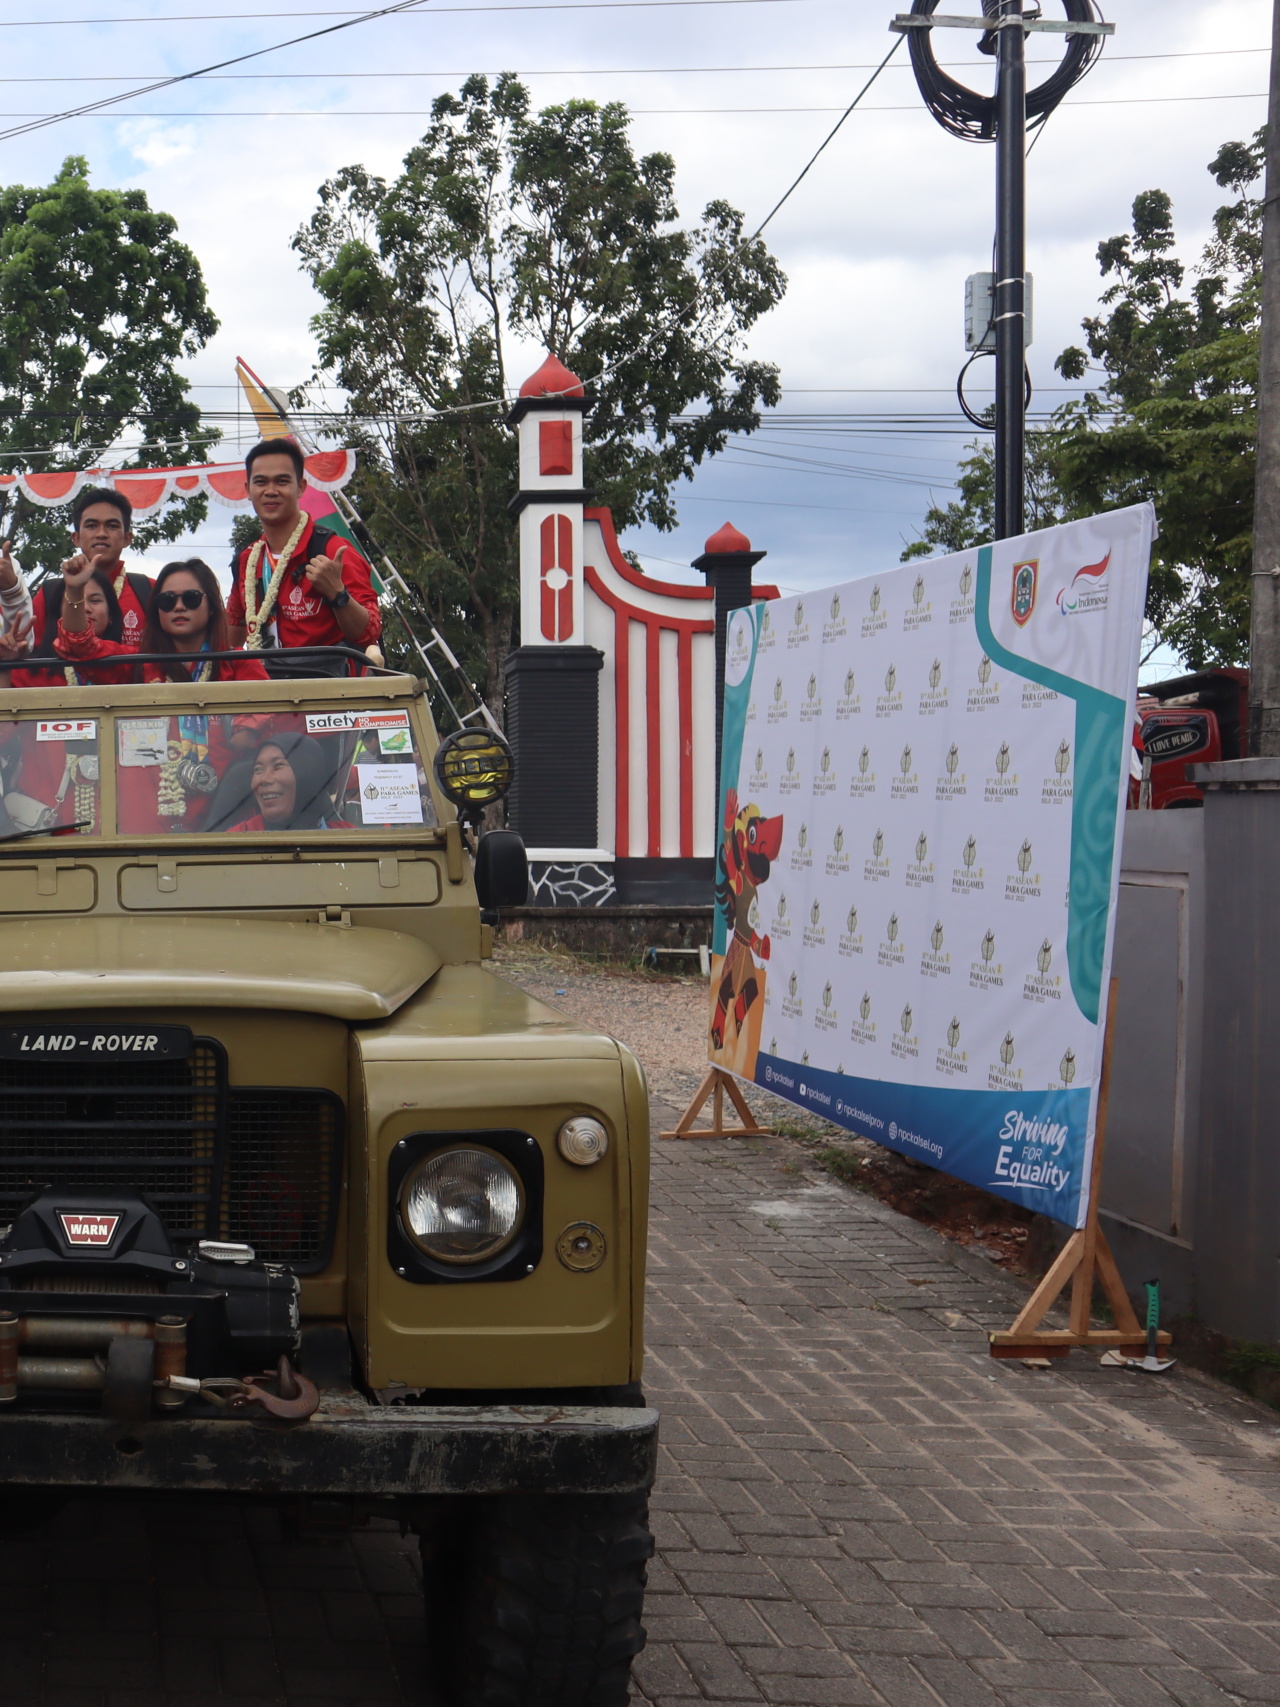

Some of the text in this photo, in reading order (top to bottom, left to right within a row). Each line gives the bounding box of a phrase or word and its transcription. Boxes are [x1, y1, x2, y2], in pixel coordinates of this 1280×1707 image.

[1078, 596, 1108, 608] Indonesia
[916, 614, 932, 623] GAMES
[967, 696, 1000, 706] PARA GAMES
[1022, 692, 1058, 702] PARA GAMES
[932, 700, 948, 708] GAMES
[309, 714, 358, 728] safety
[359, 720, 406, 728] COMPROMISE
[40, 722, 92, 733] IOF
[1153, 738, 1170, 752] LOVE
[1172, 732, 1194, 747] PEACE
[936, 786, 966, 795] PARA GAMES
[999, 788, 1018, 796] GAMES
[1042, 788, 1057, 797] PARA
[906, 873, 934, 883] PARA GAMES
[952, 878, 984, 889] PARA GAMES
[1006, 885, 1041, 897] PARA GAMES
[878, 951, 904, 963] PARA GAMES
[921, 961, 951, 974] PARA GAMES
[970, 972, 1003, 986] PARA GAMES
[1024, 984, 1061, 999] PARA GAMES
[892, 1042, 918, 1057] PARA GAMES
[936, 1056, 968, 1073] PARA GAMES
[772, 1071, 794, 1088] npckalsel
[988, 1073, 1023, 1091] PARA GAMES
[806, 1088, 832, 1106] npckalsel
[844, 1106, 884, 1130] npckalselprov
[999, 1110, 1069, 1156] Striving
[898, 1128, 943, 1159] npckalsel.org
[1022, 1146, 1043, 1161] FOR
[995, 1145, 1070, 1192] Equality
[70, 1224, 108, 1236] WARN
